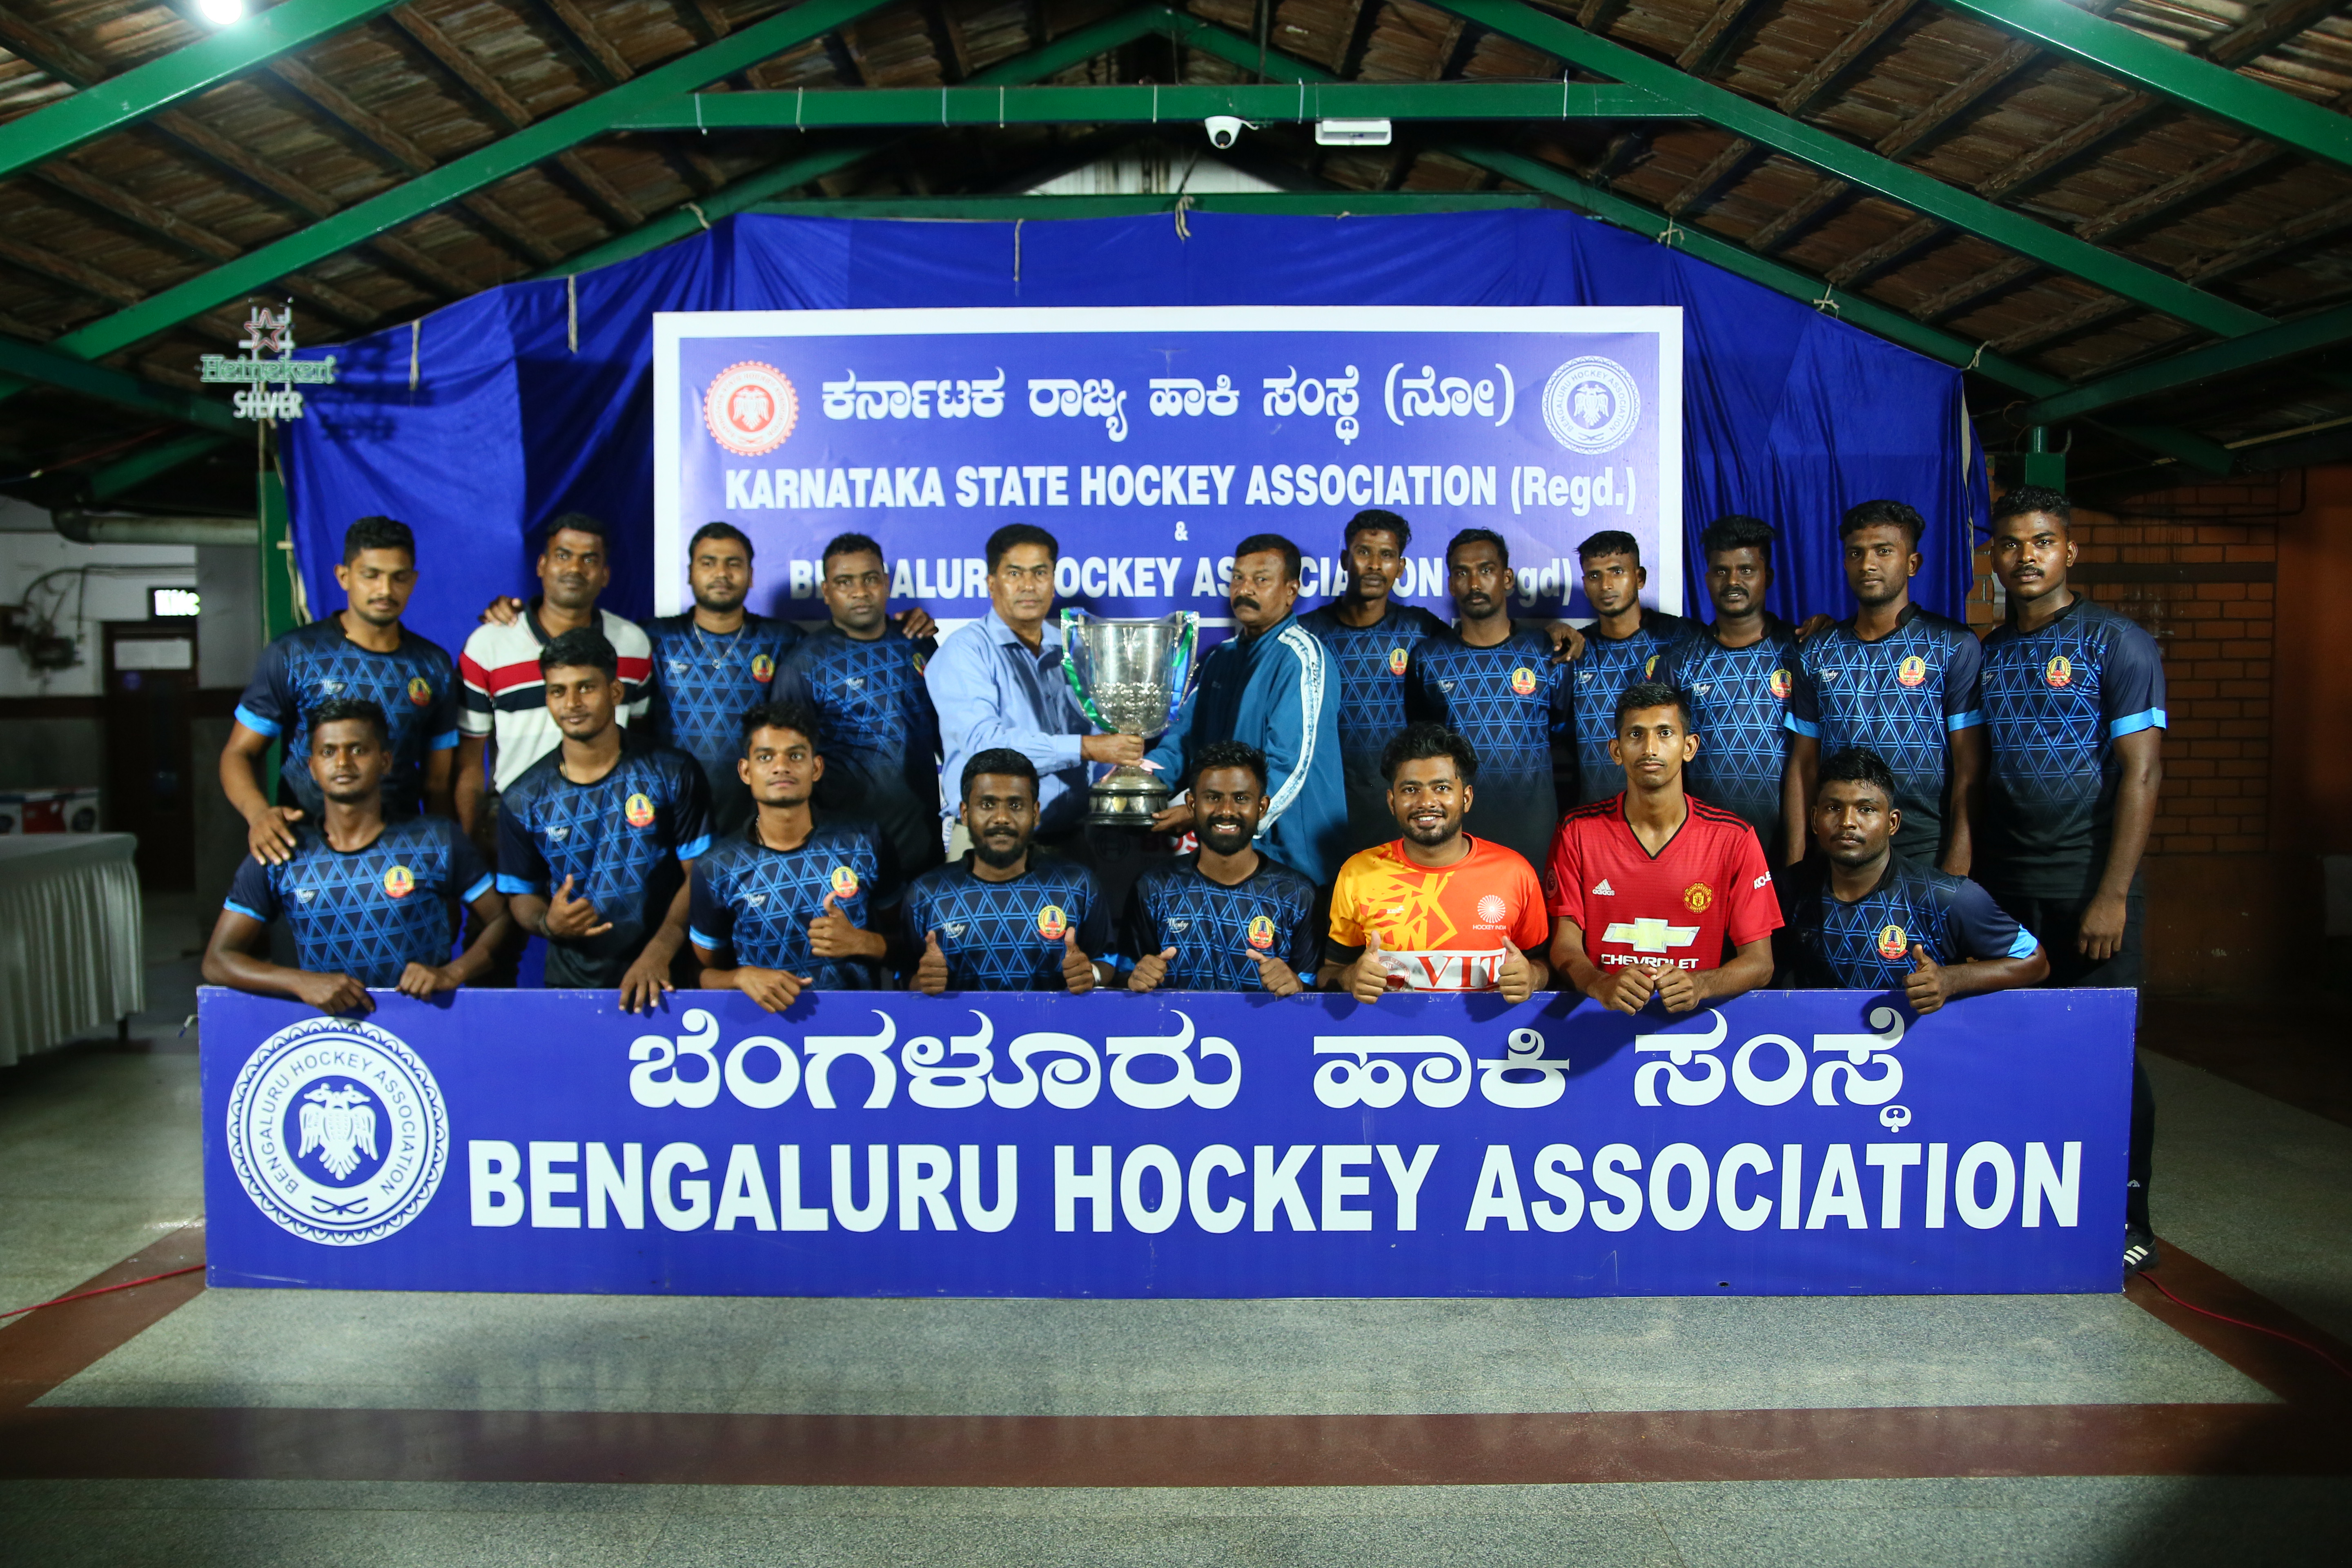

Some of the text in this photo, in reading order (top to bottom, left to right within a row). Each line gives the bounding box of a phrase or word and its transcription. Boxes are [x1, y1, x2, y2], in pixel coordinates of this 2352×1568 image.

[200, 354, 336, 384] Heineken
[233, 390, 303, 419] SILVER
[822, 366, 1005, 420] ಕರ್ನಾಟಕ
[1028, 378, 1128, 442] ರಾಜ್ಯ
[1149, 374, 1240, 416] ಹಾಕಿ
[1263, 364, 1360, 445] ಸಂಸ್ಥೆ
[1557, 370, 1626, 433] BENGALURU HOCKEY ASSOCIATION
[725, 464, 1636, 517] KARNATAKA STATE HOCKEY ASSOCIATION (Regd.)
[1174, 521, 1189, 541] &
[790, 558, 988, 599] BALUR
[1054, 557, 1182, 598] OCKEY
[1192, 557, 1443, 598] ASCIAON
[1687, 885, 1710, 896] MANCHESTER
[1414, 954, 1503, 987] VIT
[629, 1007, 1912, 1133] ಬೆಂಗಳೂರು ಹಾಕಿ ಸಂಸ್ಥೆ
[260, 1051, 416, 1196] BENGALURU HOCKEY ASSOCIATION
[468, 1140, 2082, 1233] BENGALURU HOCKEY ASSOCIATION
